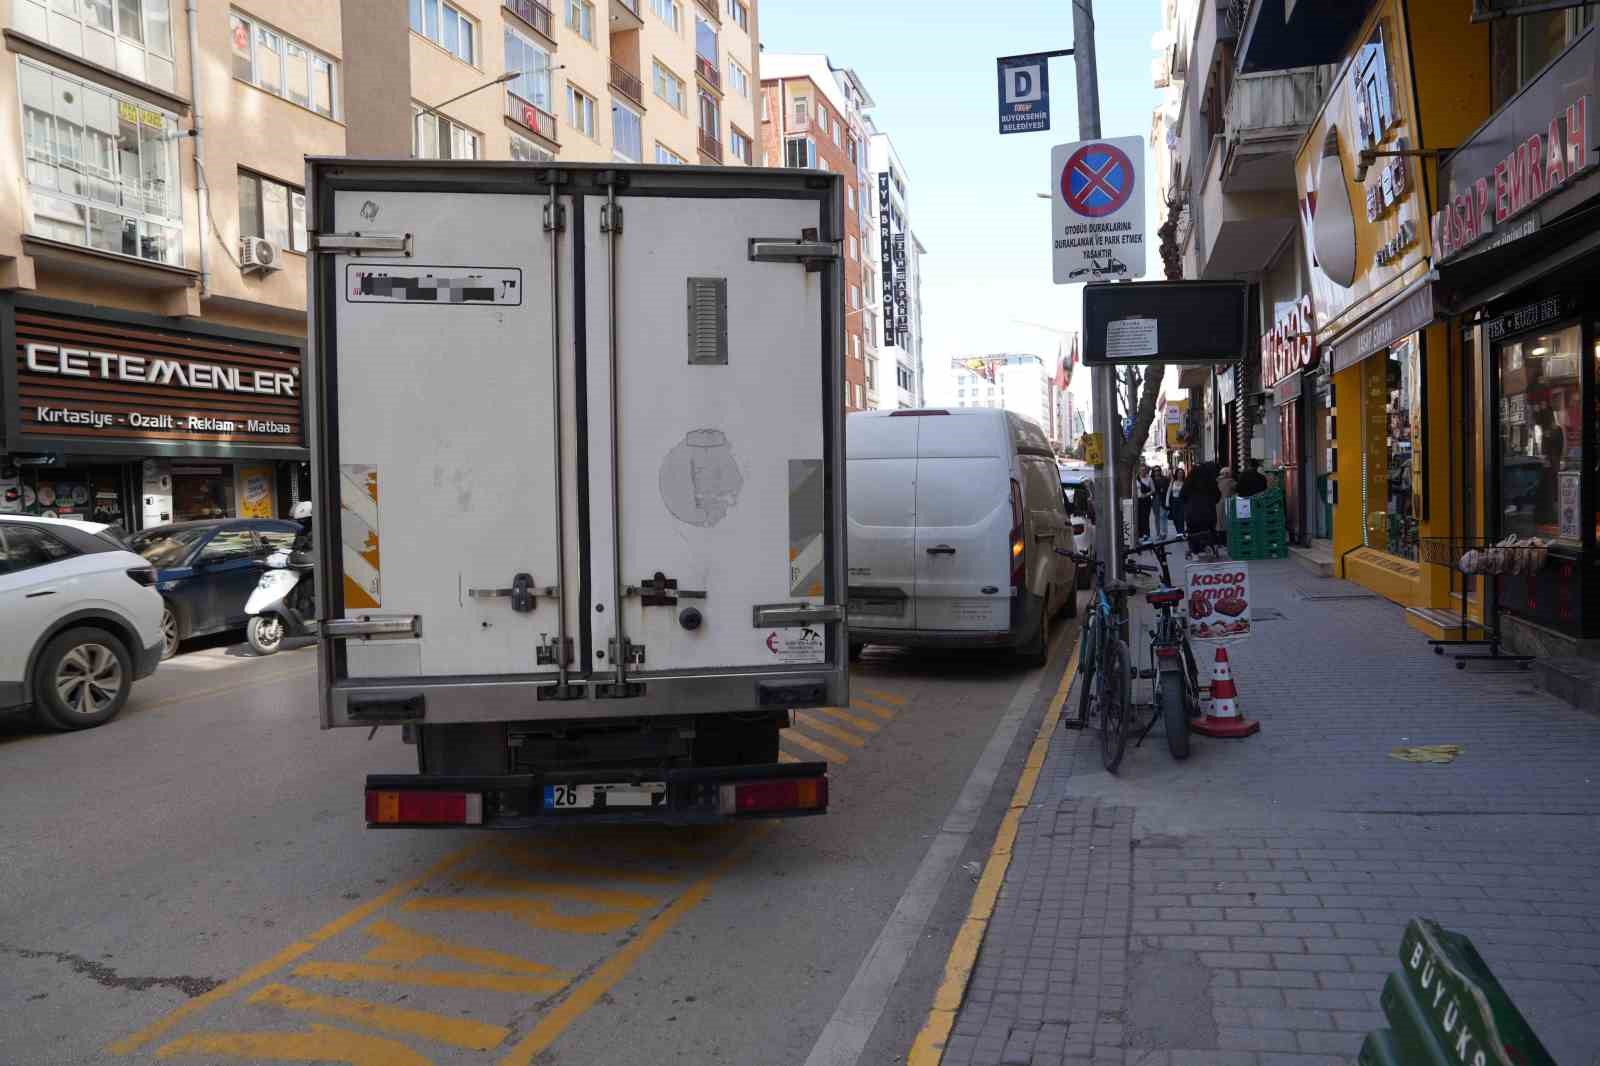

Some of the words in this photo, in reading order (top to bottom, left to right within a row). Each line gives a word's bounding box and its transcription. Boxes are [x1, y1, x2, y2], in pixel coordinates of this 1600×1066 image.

[1014, 70, 1032, 97] D
[1432, 177, 1489, 263] KASAP
[1494, 96, 1586, 224] EMRAH
[880, 177, 891, 263] TYMBRIS
[1096, 236, 1103, 246] VE
[1104, 234, 1120, 245] PARK
[1121, 233, 1143, 244] ETMEK
[1083, 248, 1112, 259] YASAKTIR
[884, 281, 894, 342] HOTEL
[26, 343, 295, 396] CETEMENLER
[188, 416, 234, 431] Reklam
[247, 421, 290, 433] Matbaa
[1191, 572, 1245, 586] kasap
[555, 787, 577, 806] 26
